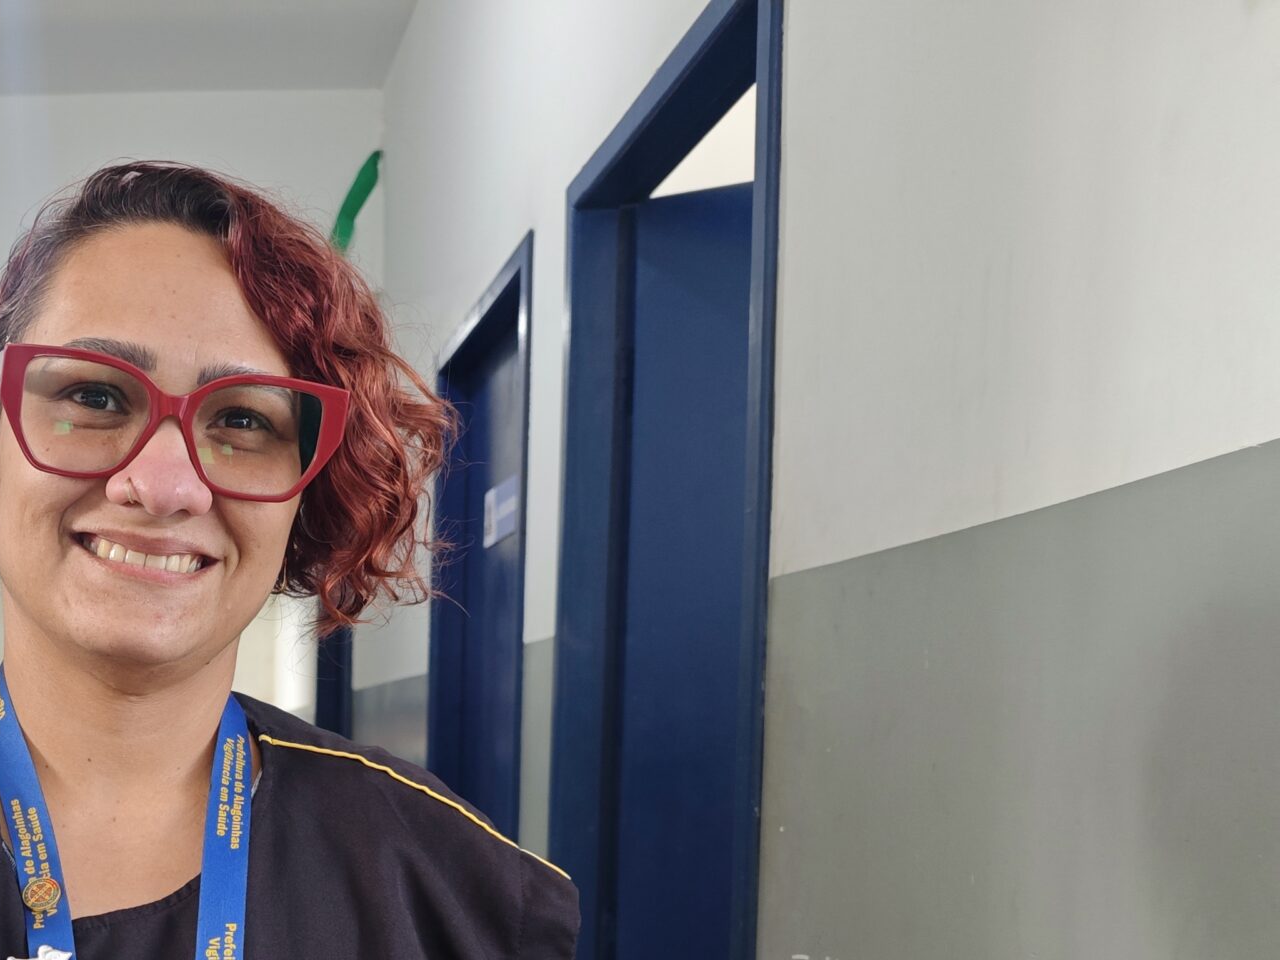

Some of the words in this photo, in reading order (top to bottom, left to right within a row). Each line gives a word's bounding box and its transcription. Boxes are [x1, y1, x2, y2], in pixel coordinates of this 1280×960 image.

[222, 738, 235, 786] Vigilância
[235, 733, 246, 780] Prefeitura
[220, 787, 229, 802] em
[234, 781, 245, 793] de
[10, 798, 33, 858] Alagoinhas
[27, 806, 44, 842] Saúde
[216, 804, 230, 837] Saúde
[230, 794, 245, 849] Alagoinhas
[24, 859, 36, 875] de
[36, 842, 49, 861] em
